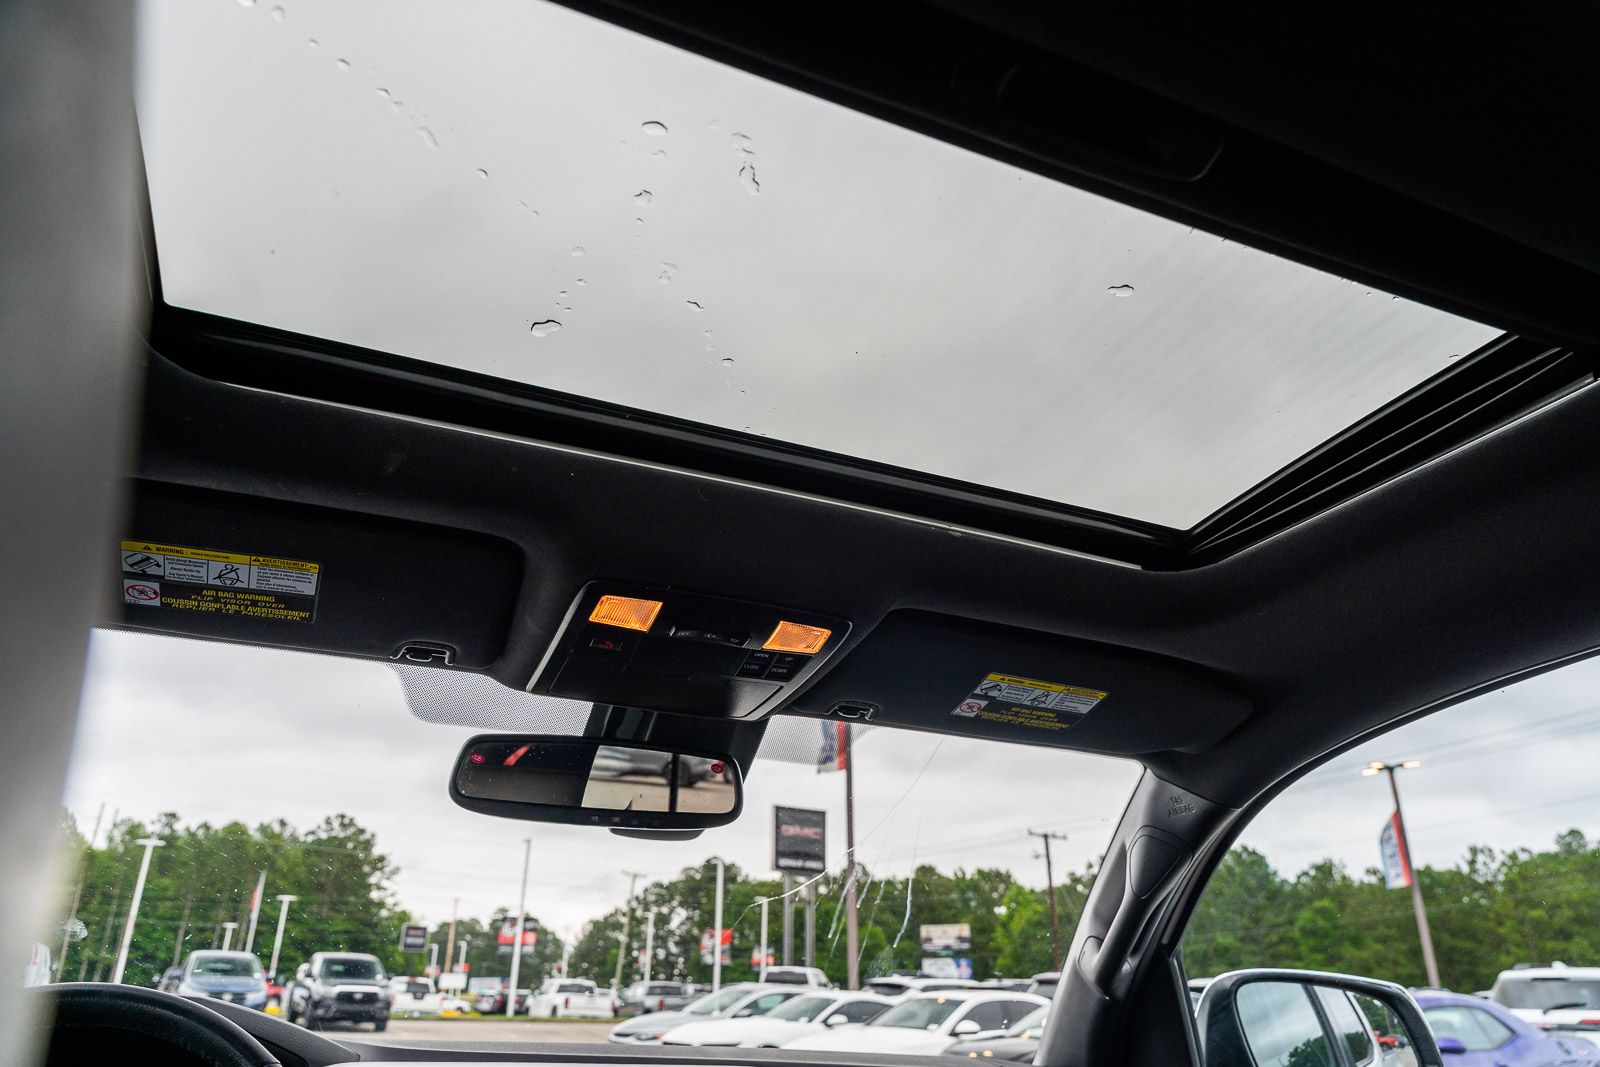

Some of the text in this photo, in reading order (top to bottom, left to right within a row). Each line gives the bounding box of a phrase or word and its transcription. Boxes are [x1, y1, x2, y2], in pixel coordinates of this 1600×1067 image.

[155, 546, 185, 556] WARNING
[202, 589, 276, 602] AIR BAG WARNING
[162, 597, 310, 618] COUSSIN GONFLABLE AVERTISSEMENT
